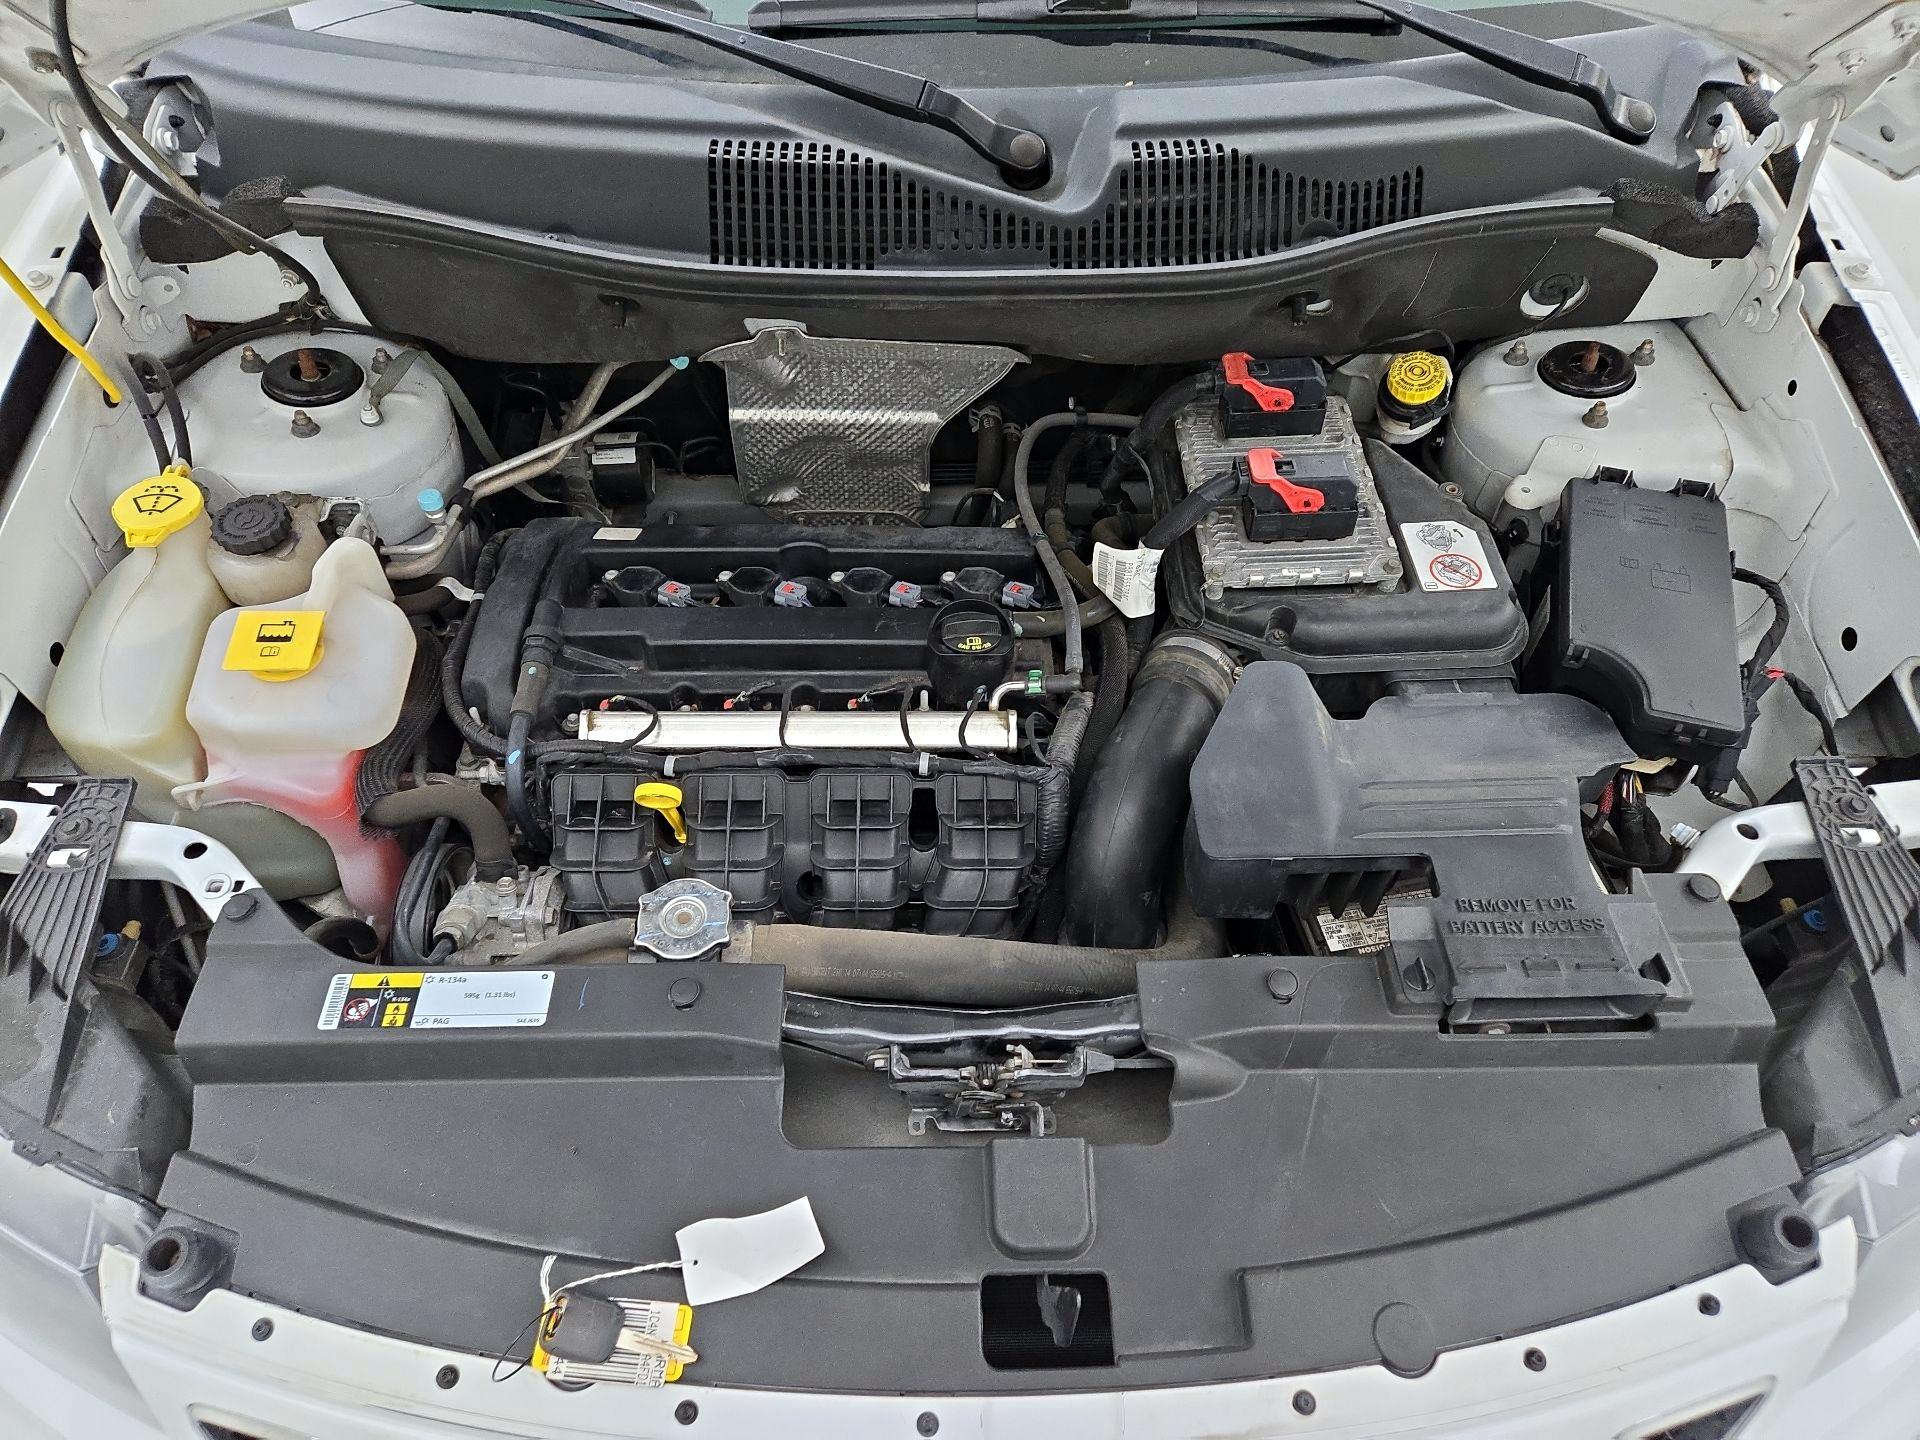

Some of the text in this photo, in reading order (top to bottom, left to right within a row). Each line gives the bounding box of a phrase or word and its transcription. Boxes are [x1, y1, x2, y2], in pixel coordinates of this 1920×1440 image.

[1456, 896, 1578, 913] REMOVE FOR
[1449, 917, 1606, 935] BATTERY ACCESS
[438, 976, 467, 984] R-134a
[432, 1017, 450, 1025] PAG
